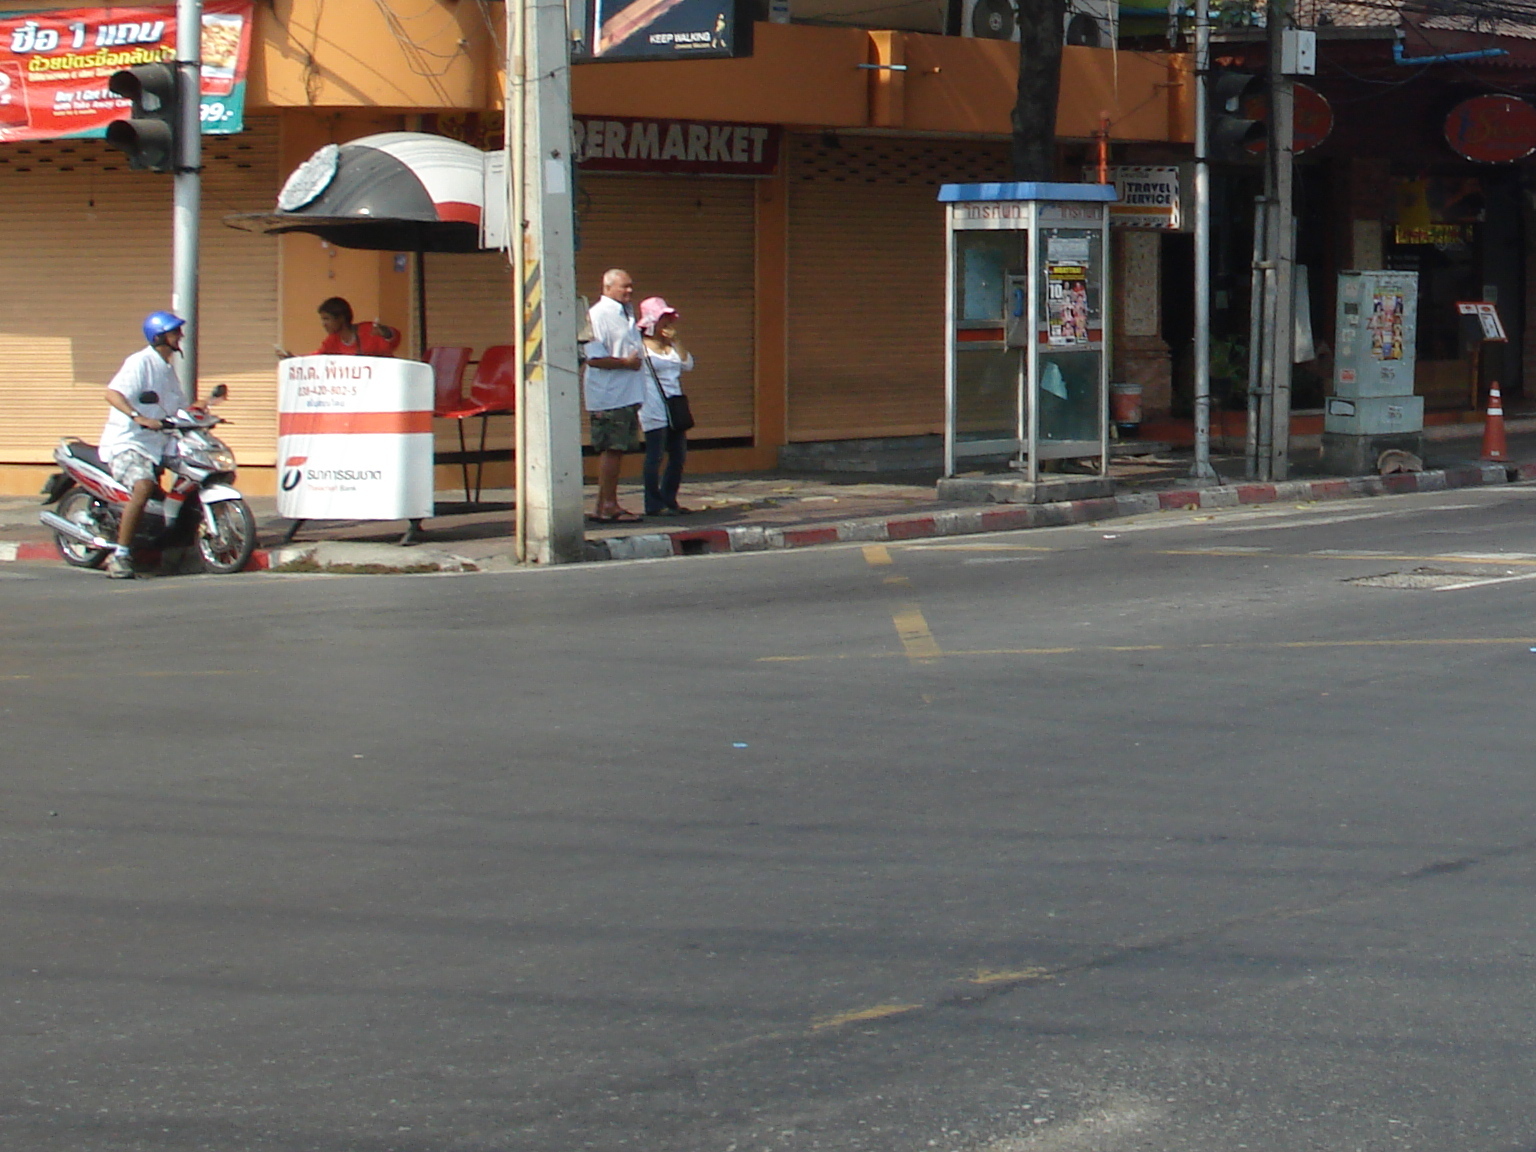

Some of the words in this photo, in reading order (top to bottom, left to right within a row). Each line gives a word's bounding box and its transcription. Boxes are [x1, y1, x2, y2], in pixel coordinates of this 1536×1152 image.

[10, 20, 59, 54] ซื้อ
[69, 22, 86, 49] 1
[649, 33, 673, 45] KEEP
[674, 31, 711, 43] WALKING
[76, 90, 82, 102] 1
[1126, 181, 1171, 193] TRAVEL
[1126, 193, 1171, 205] SERVICE
[1049, 283, 1063, 299] 10
[325, 360, 373, 380] พัทยา
